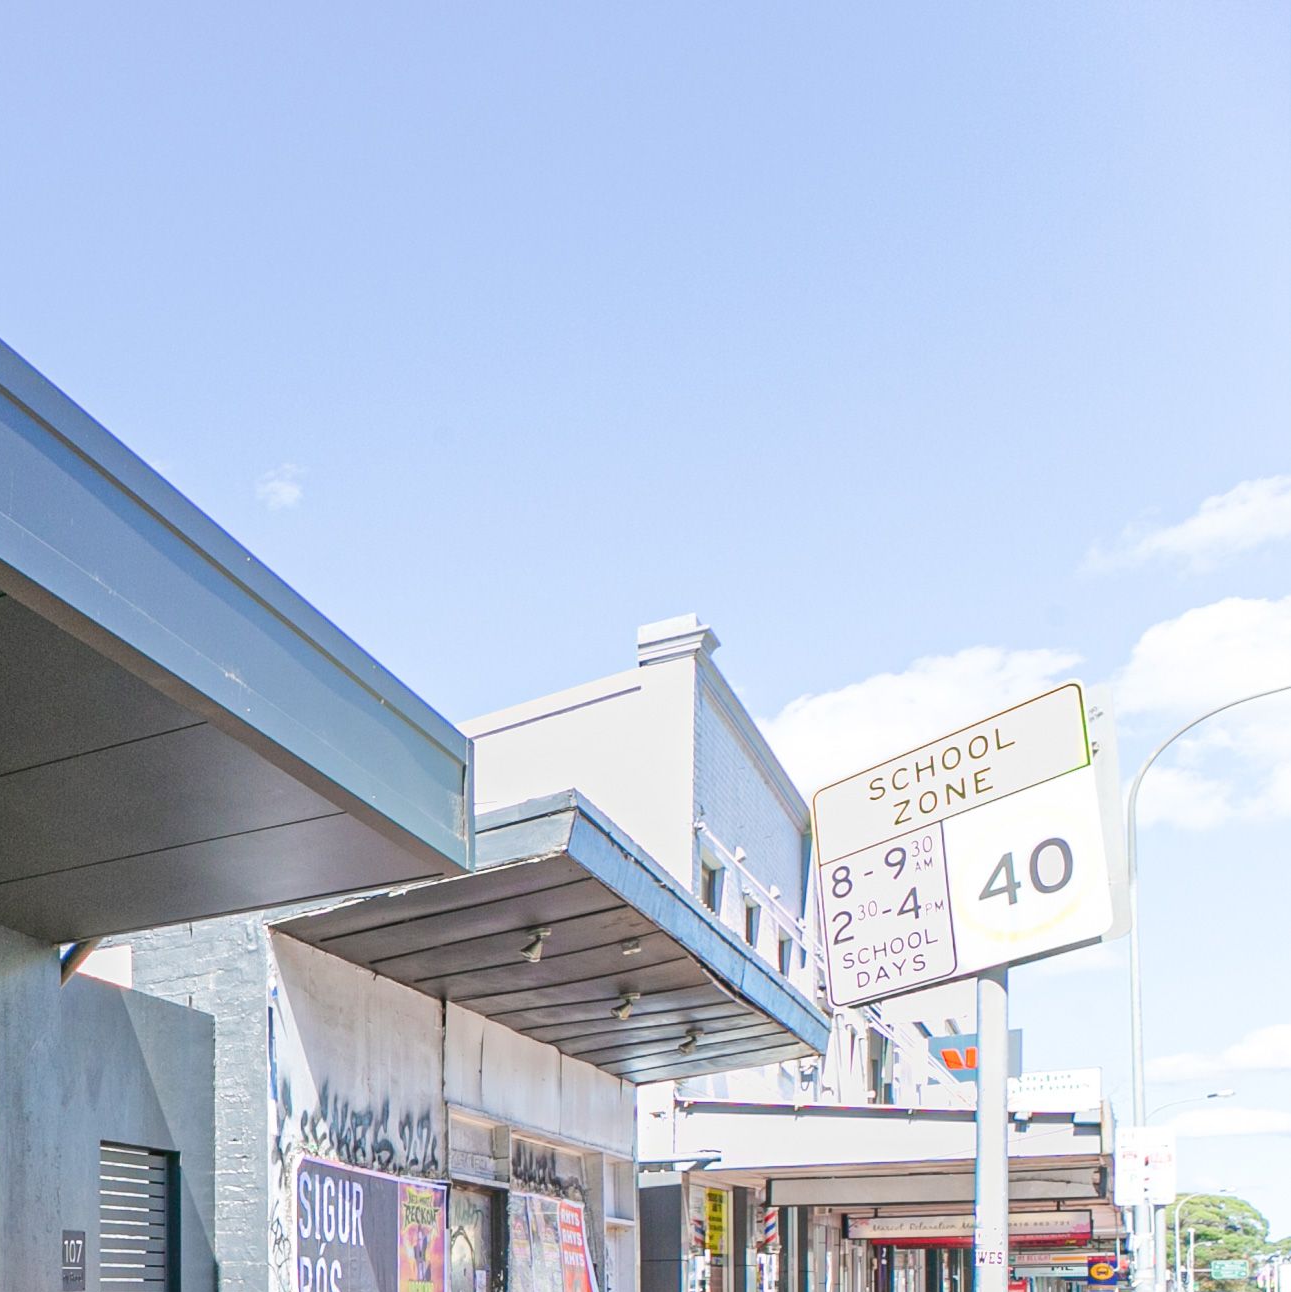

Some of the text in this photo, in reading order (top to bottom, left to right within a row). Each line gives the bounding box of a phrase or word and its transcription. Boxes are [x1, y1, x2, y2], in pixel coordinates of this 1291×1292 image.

[869, 729, 1015, 801] SCHOOL
[894, 767, 993, 825] ZONE
[978, 837, 1073, 905] 40
[843, 929, 938, 970] SCHOOL
[858, 954, 926, 988] DAYS
[299, 1171, 364, 1246] SIGUR
[64, 1240, 83, 1263] 107
